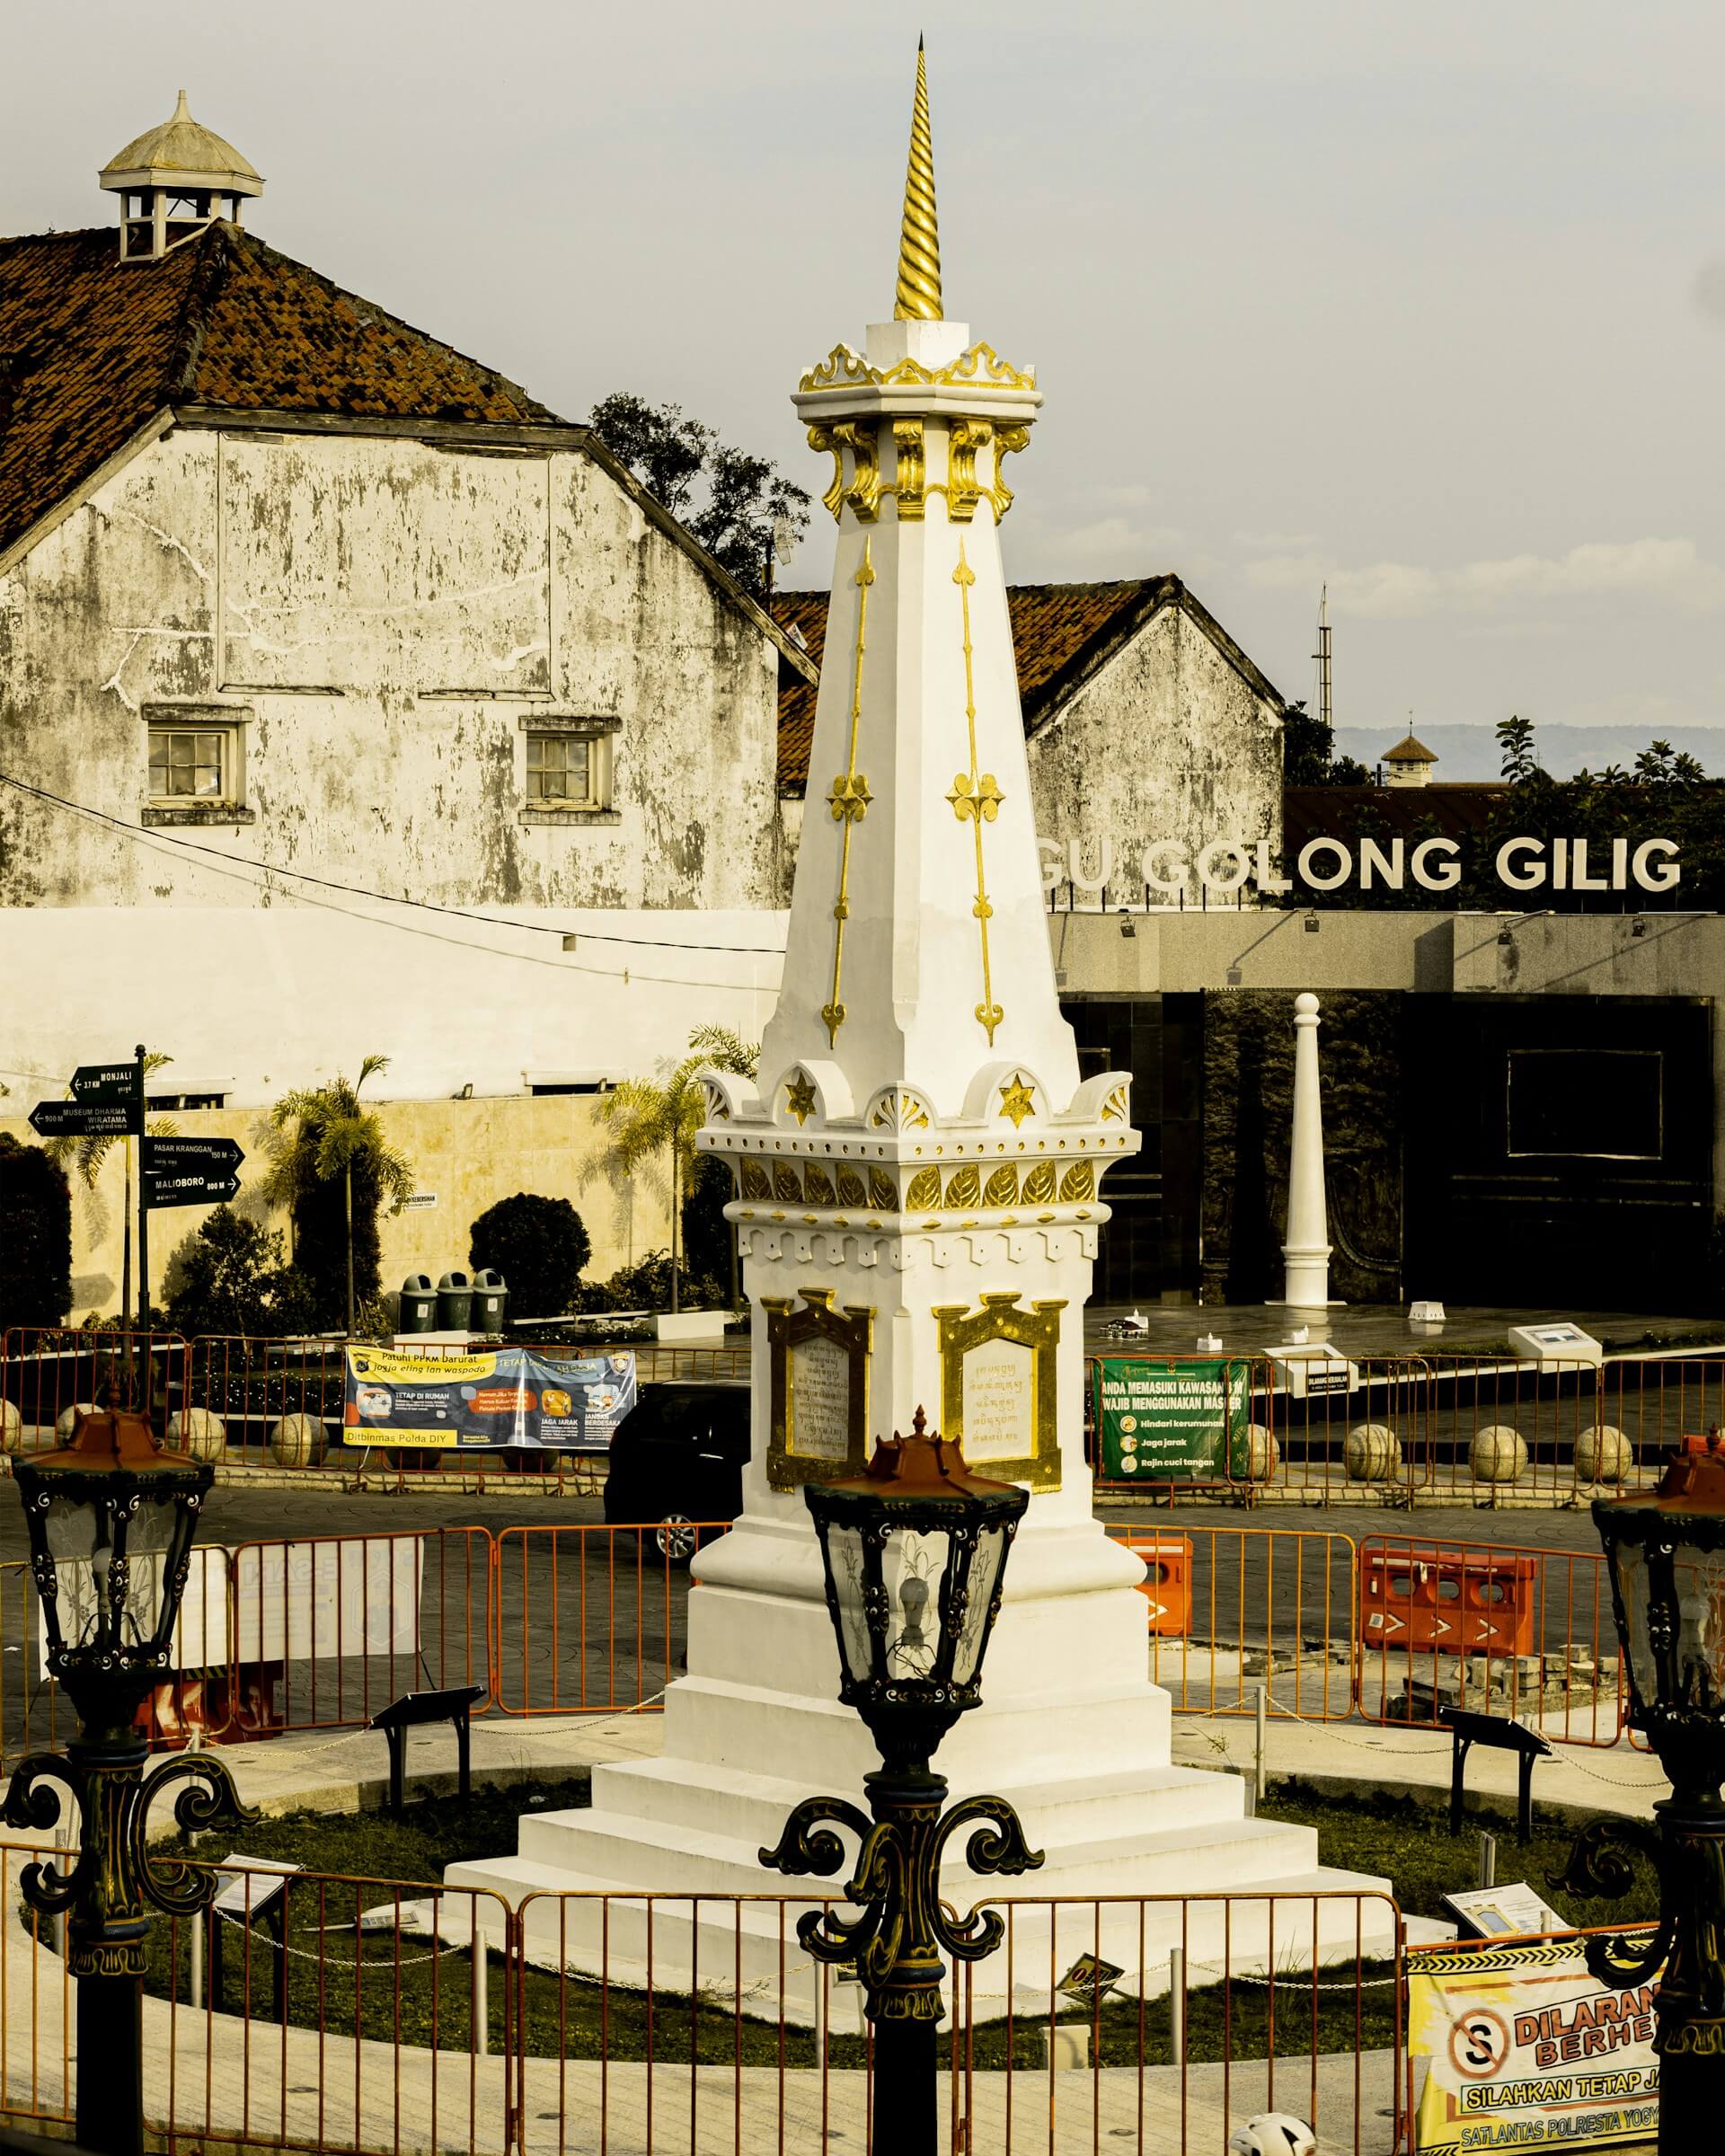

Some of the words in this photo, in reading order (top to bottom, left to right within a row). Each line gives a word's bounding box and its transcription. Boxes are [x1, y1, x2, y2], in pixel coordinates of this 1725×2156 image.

[1141, 836, 1461, 892] GOLONG
[1496, 836, 1681, 892] GILIG
[101, 1071, 132, 1082] MONJALI
[92, 1080, 101, 1089] KM
[63, 1108, 93, 1117] MUSEUM
[94, 1108, 127, 1116] DHARMA
[87, 1116, 127, 1124] WIRATAMA
[154, 1144, 175, 1152] PASAR
[175, 1144, 213, 1153] KRANGGAN
[221, 1151, 227, 1159] M
[155, 1176, 205, 1189] MALIOBORO
[218, 1181, 226, 1189] M
[382, 1352, 411, 1362] Patuhi
[413, 1353, 439, 1363] PPKM
[442, 1354, 478, 1364] Darurat
[426, 1364, 441, 1374] lan
[1101, 1381, 1126, 1395] ANDA
[1128, 1381, 1177, 1395] MEMASUKI
[1178, 1381, 1225, 1395] KAWASAN
[395, 1392, 416, 1400] TETAP
[425, 1392, 449, 1401] RUMAH
[1102, 1397, 1130, 1410] WAJIB
[1132, 1396, 1202, 1410] MENGGUNAKAN
[541, 1418, 557, 1426] JAGA
[558, 1418, 579, 1427] JARAK
[1140, 1419, 1172, 1428] Hindari
[1173, 1419, 1225, 1428] kerumunan
[347, 1432, 395, 1442] Ditbinmas
[399, 1434, 427, 1443] Polda
[429, 1434, 447, 1444] DIY
[1141, 1438, 1163, 1449] Jaga
[1163, 1437, 1187, 1449] jarak
[1141, 1457, 1163, 1469] Rajin
[1163, 1457, 1182, 1467] cuci
[1183, 1457, 1215, 1469] tangan
[1535, 2012, 1660, 2066] BERHE
[1466, 2078, 1573, 2109] SILAHKAN
[1576, 2071, 1641, 2098] TETAP
[1461, 2120, 1544, 2147] SATLANTAS
[1548, 2111, 1622, 2138] POLRESTA
